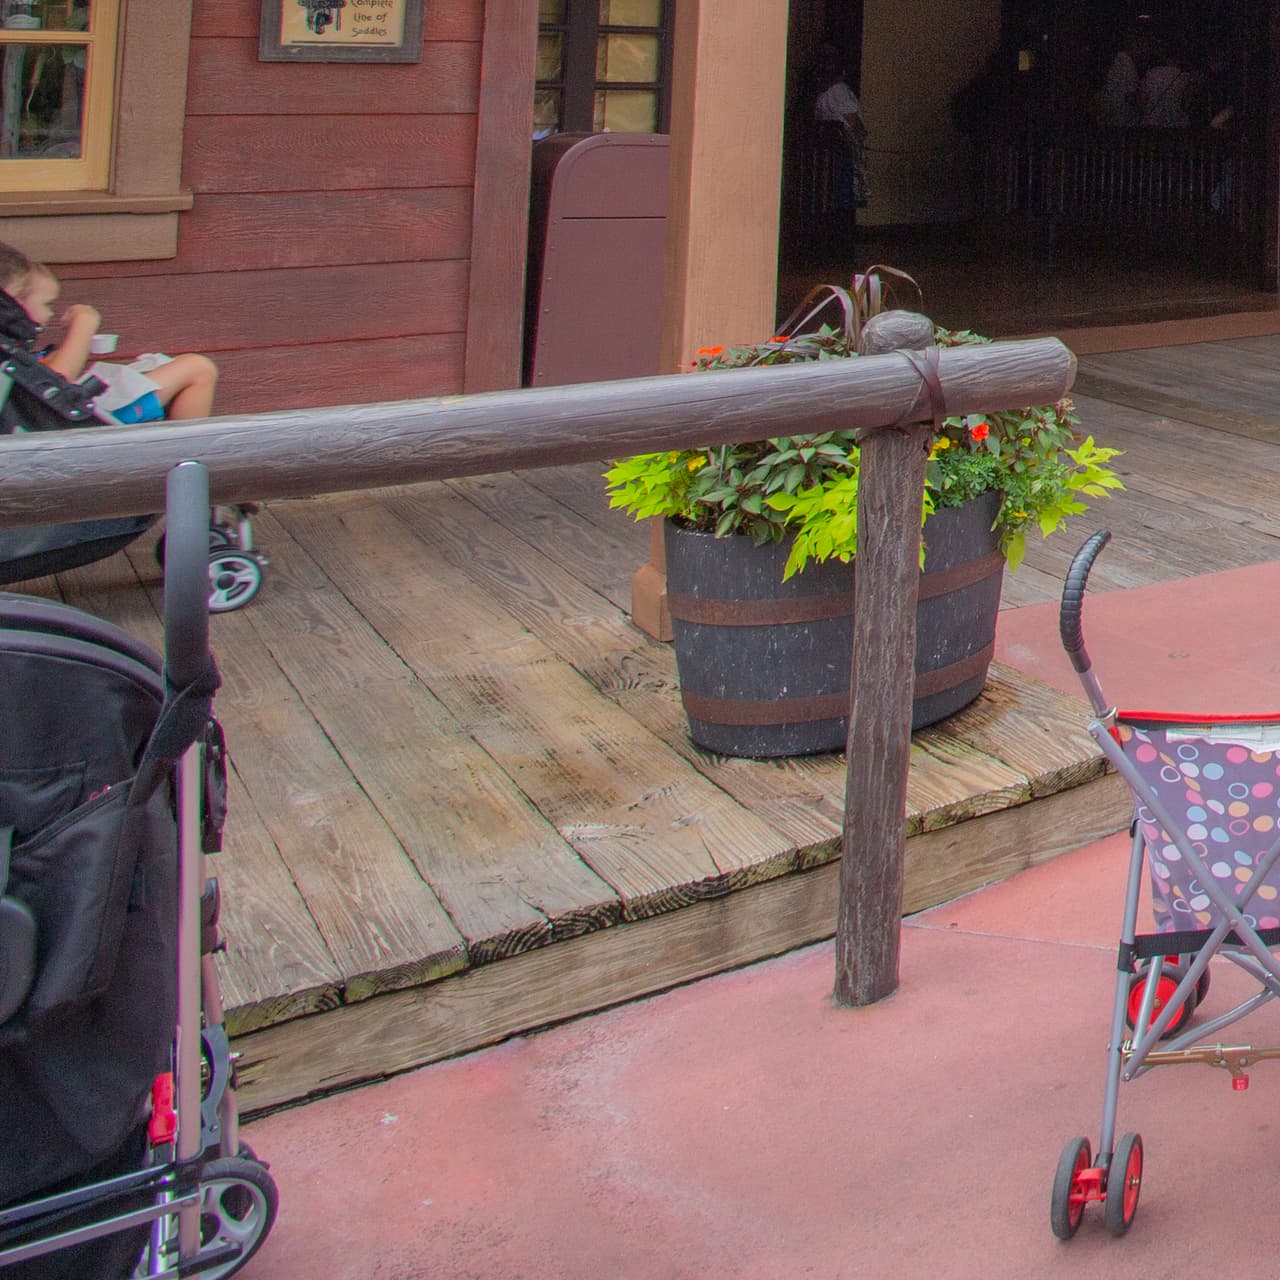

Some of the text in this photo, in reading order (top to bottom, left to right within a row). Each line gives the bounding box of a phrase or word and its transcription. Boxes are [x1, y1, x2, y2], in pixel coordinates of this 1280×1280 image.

[354, 12, 388, 23] Line of
[352, 26, 387, 37] Saddles
